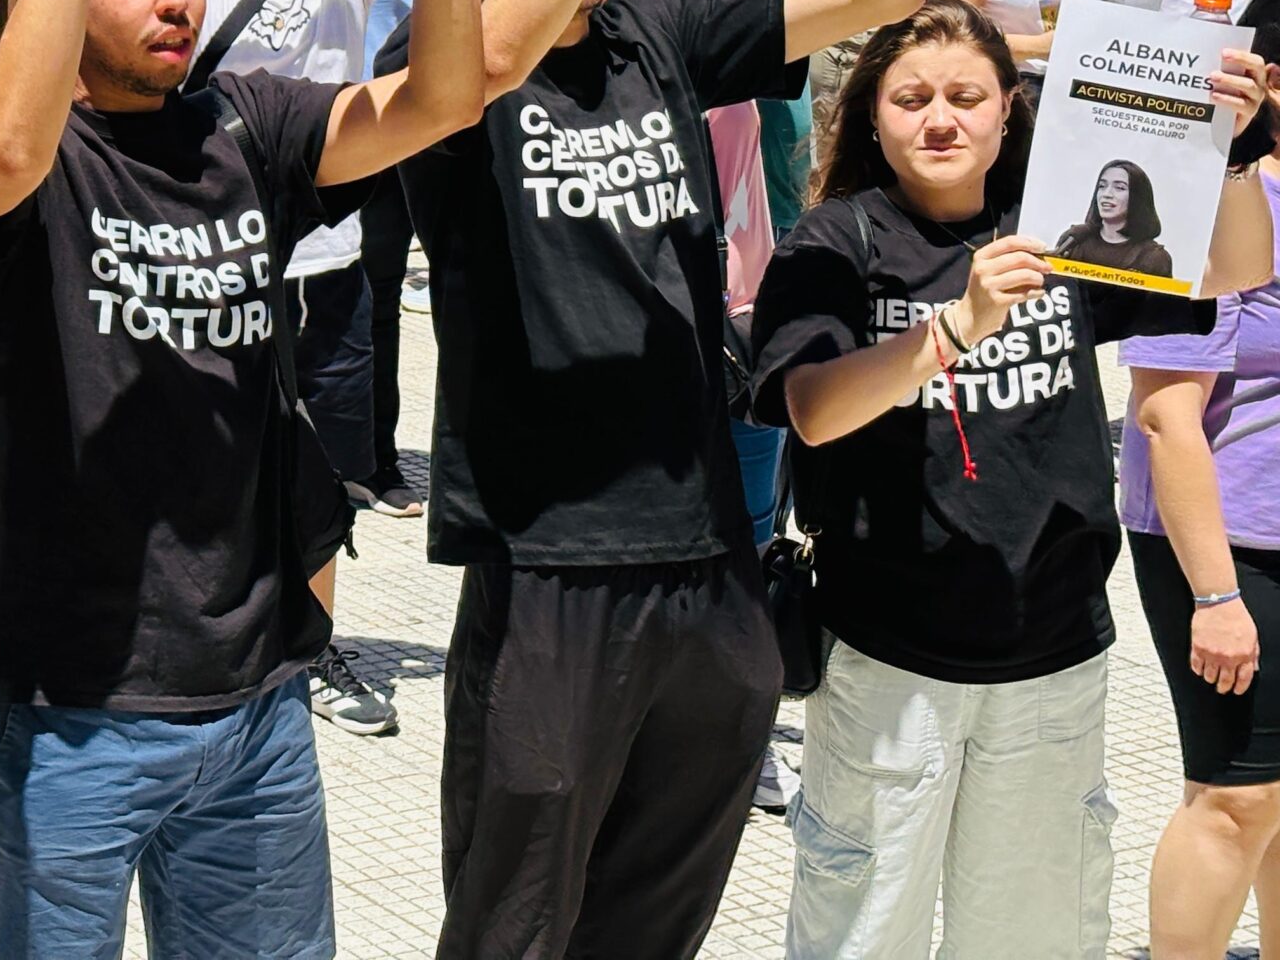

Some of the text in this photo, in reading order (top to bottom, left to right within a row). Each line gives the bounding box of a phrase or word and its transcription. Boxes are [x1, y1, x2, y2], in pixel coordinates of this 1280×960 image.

[1107, 39, 1200, 68] ALBANY
[1079, 54, 1214, 90] COLMENARES
[1076, 85, 1206, 118] ACTIVISTA POLÍTICO
[1092, 107, 1190, 131] SECUESTRADA POR
[1094, 117, 1186, 140] NICOLÁS MADURO
[1064, 265, 1146, 286] #QueSeanTodos
[1010, 285, 1070, 327] LOS
[894, 355, 1076, 412] RTURA
